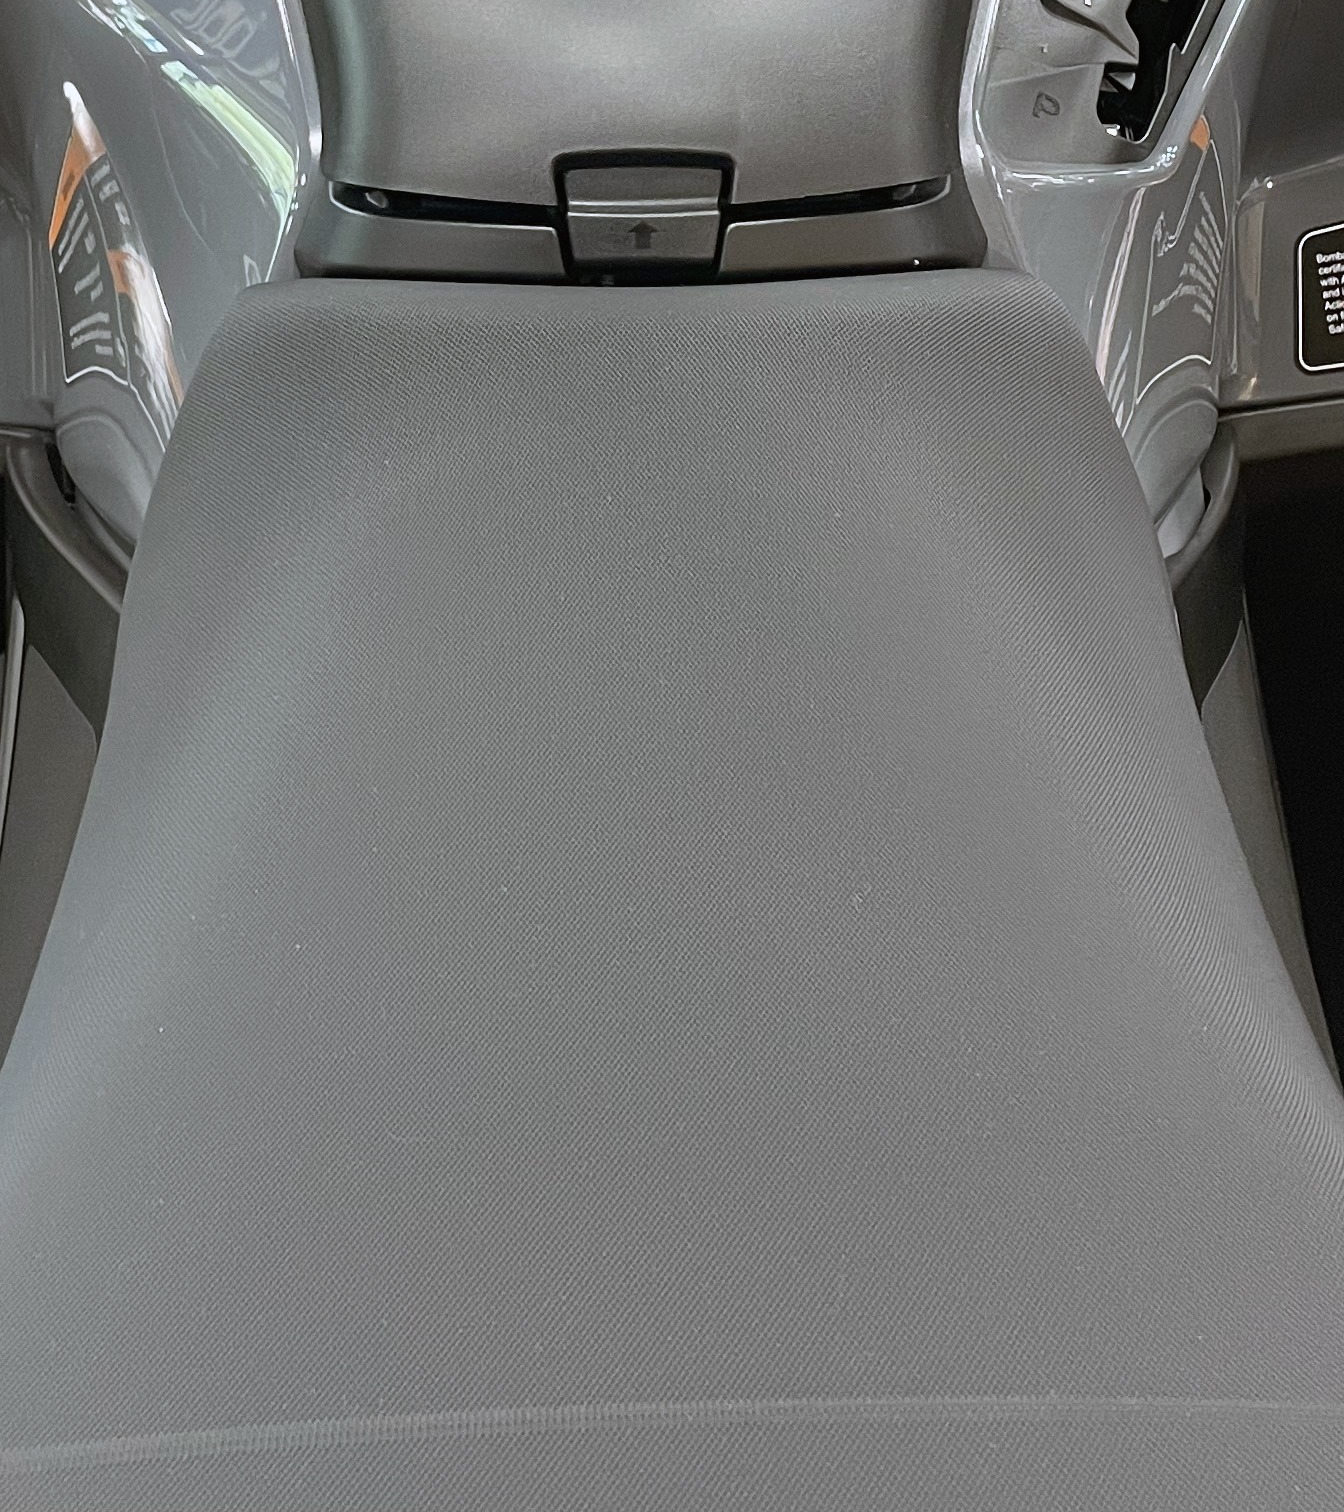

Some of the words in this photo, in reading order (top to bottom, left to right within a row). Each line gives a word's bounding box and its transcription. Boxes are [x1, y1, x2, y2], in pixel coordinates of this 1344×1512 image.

[1320, 274, 1340, 286] with
[1323, 286, 1339, 299] and
[1326, 313, 1338, 322] on
